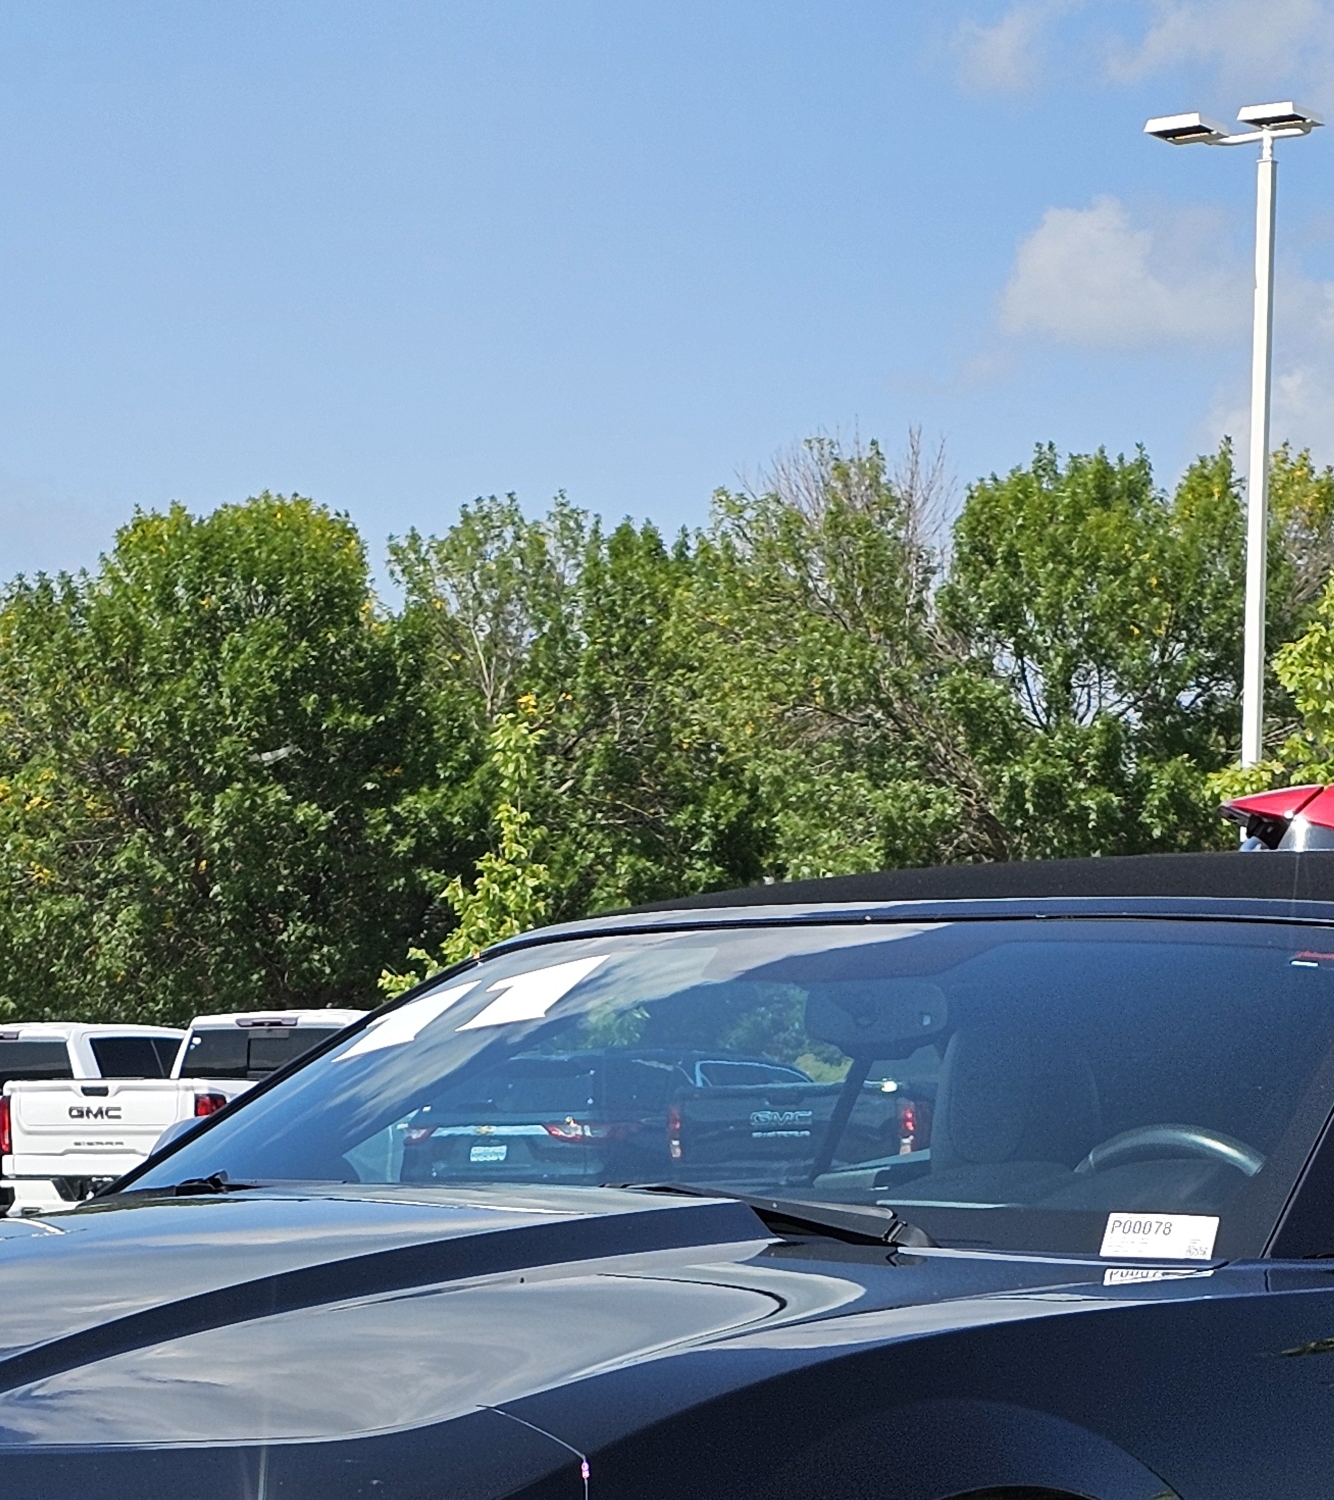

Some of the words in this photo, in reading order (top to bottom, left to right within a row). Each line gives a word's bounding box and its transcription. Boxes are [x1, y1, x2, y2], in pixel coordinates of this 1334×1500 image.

[68, 1105, 122, 1120] GMC
[750, 1110, 813, 1126] GMC
[1110, 1219, 1173, 1236] P00078
